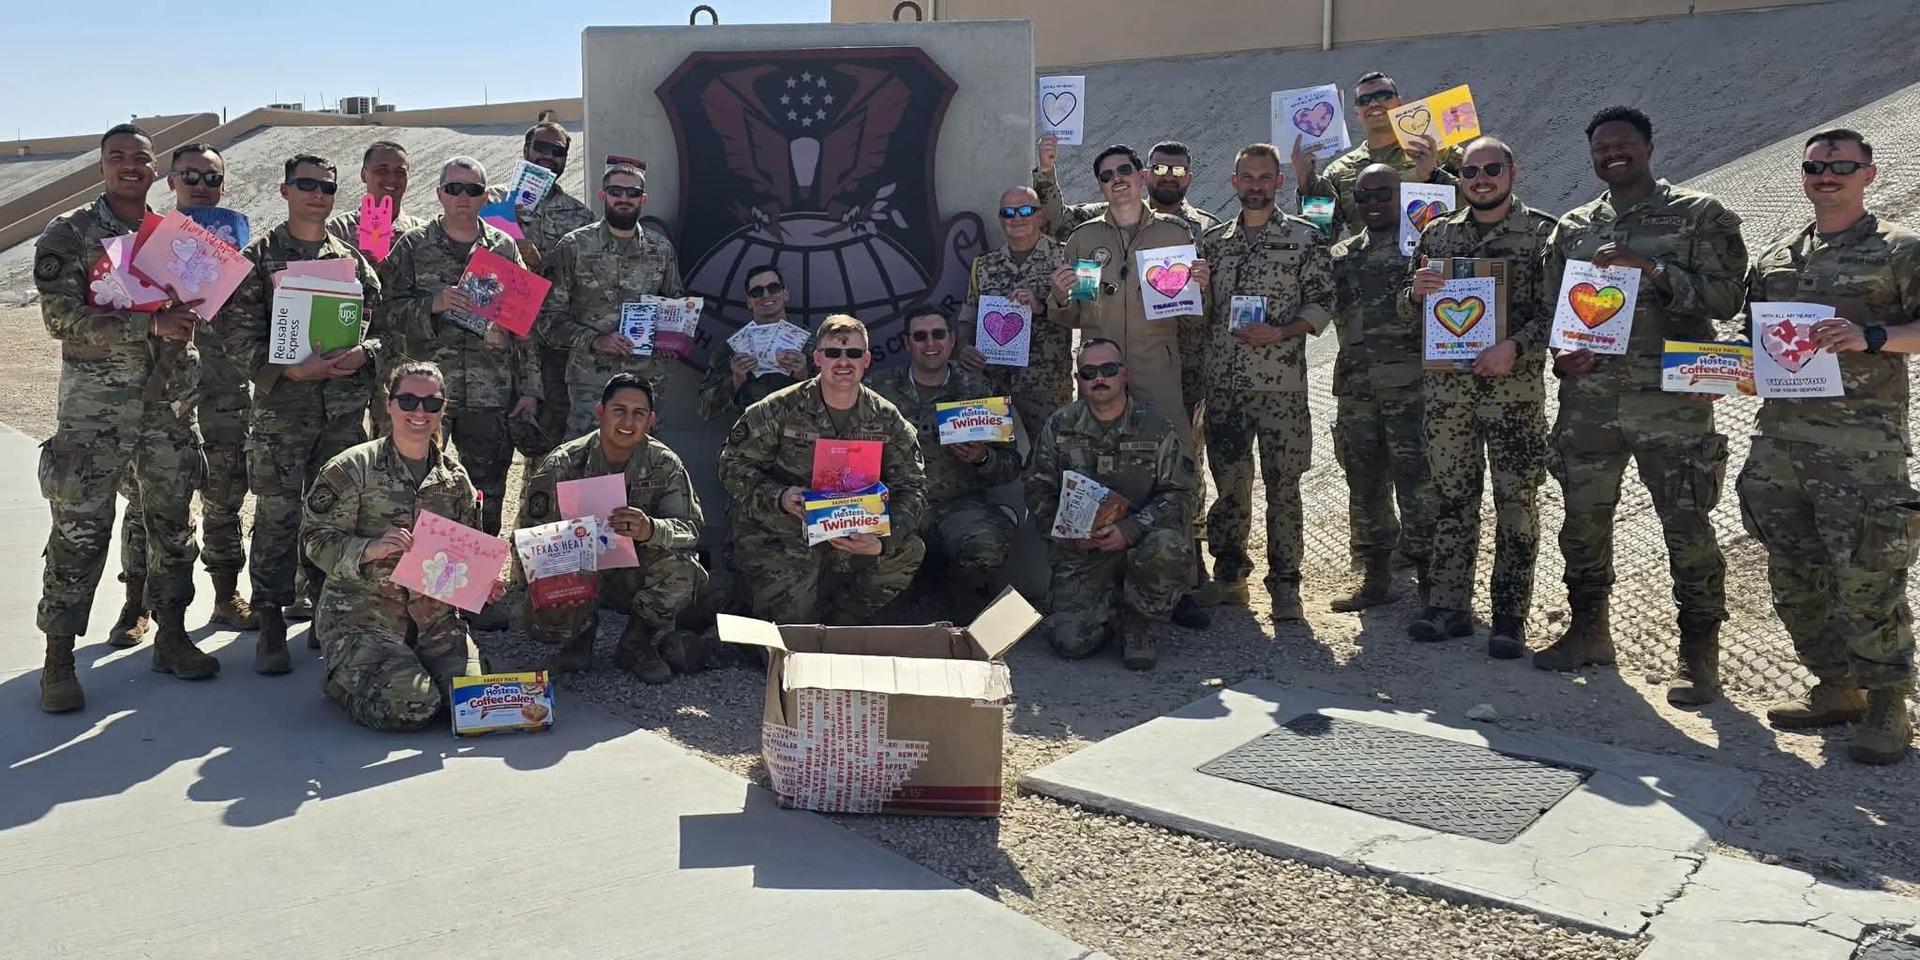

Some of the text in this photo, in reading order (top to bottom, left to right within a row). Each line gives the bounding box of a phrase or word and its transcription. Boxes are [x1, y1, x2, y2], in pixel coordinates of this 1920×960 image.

[340, 309, 357, 322] ups
[275, 307, 288, 359] Reusable
[286, 319, 300, 360] Express
[1700, 357, 1737, 367] Hostess
[949, 415, 1003, 429] Twinkies
[834, 509, 864, 519] Hostess
[820, 515, 880, 532] Twinkies
[531, 538, 584, 557] TEXAS HEAT
[486, 688, 518, 696] Hostess
